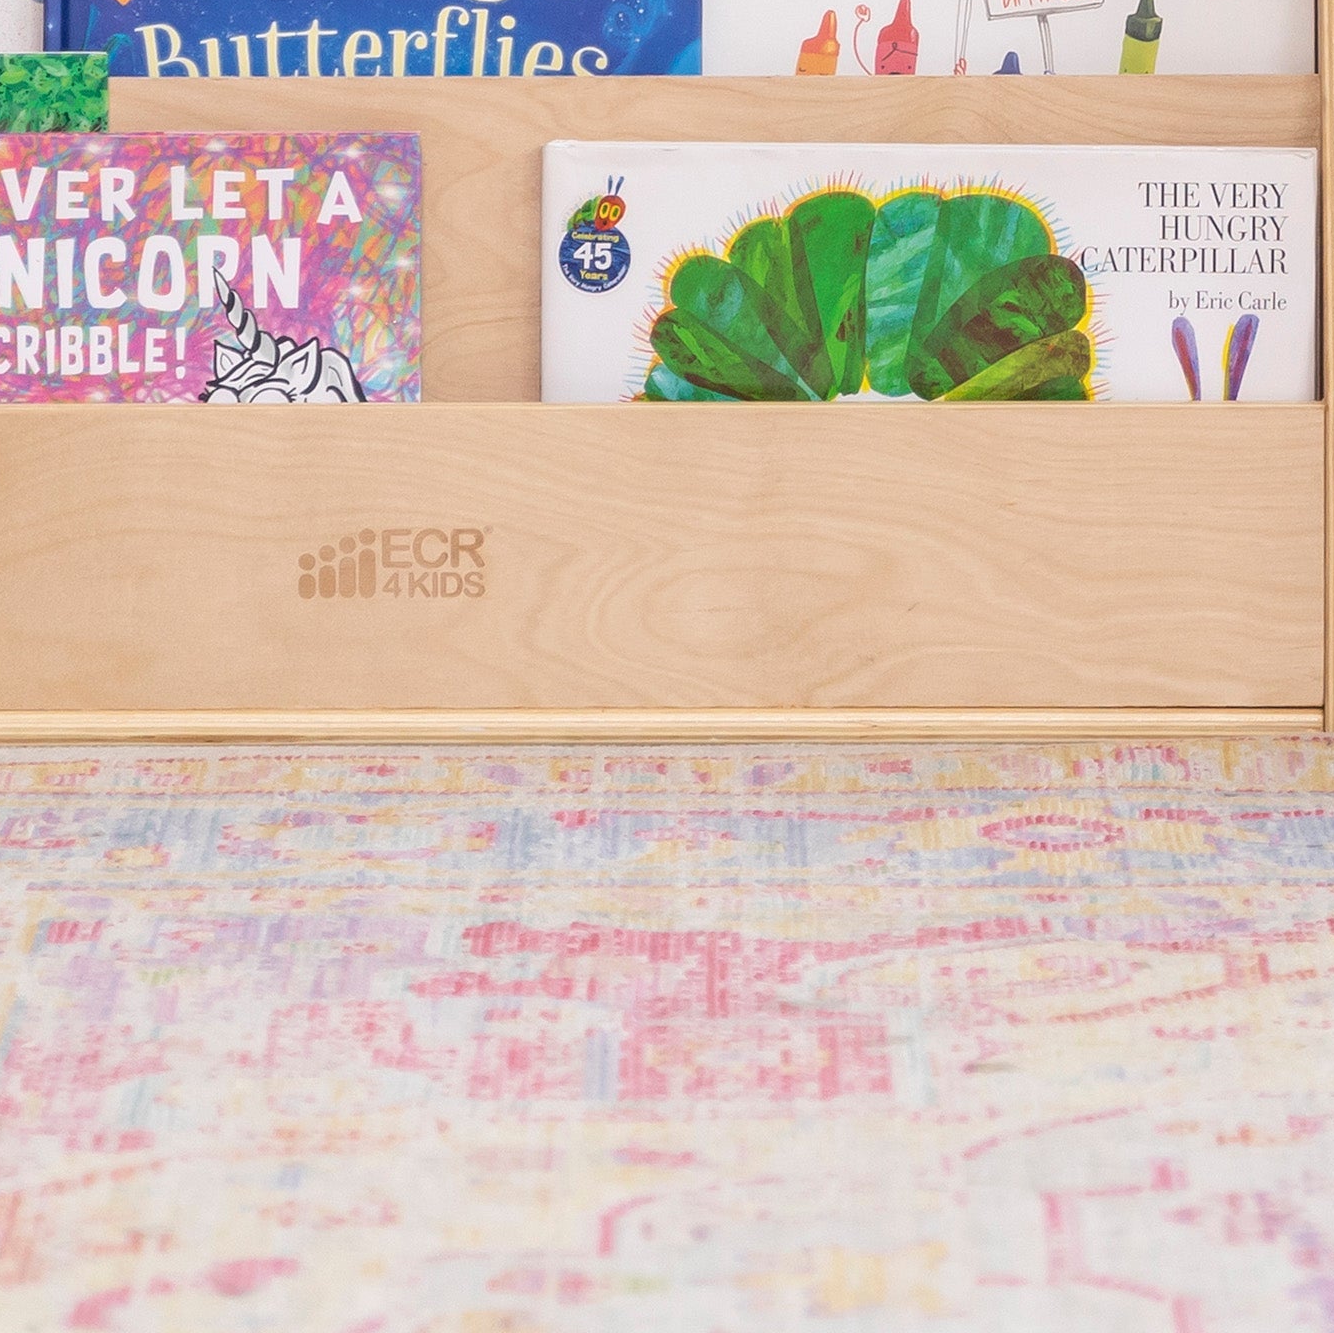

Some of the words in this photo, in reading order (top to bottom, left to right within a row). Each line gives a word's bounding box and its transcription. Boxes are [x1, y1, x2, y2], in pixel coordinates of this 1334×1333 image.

[135, 6, 608, 76] Butterflies
[170, 166, 295, 221] LET
[317, 171, 363, 225] A
[1138, 183, 1200, 208] THE
[1209, 183, 1288, 209] VERY
[1159, 215, 1289, 241] HUNGRY
[573, 242, 612, 270] 45
[1081, 246, 1289, 274] CATERPILLAR
[580, 270, 608, 280] Years
[1169, 291, 1190, 315] by
[1196, 291, 1233, 310] Eric
[1238, 291, 1287, 310] Carle
